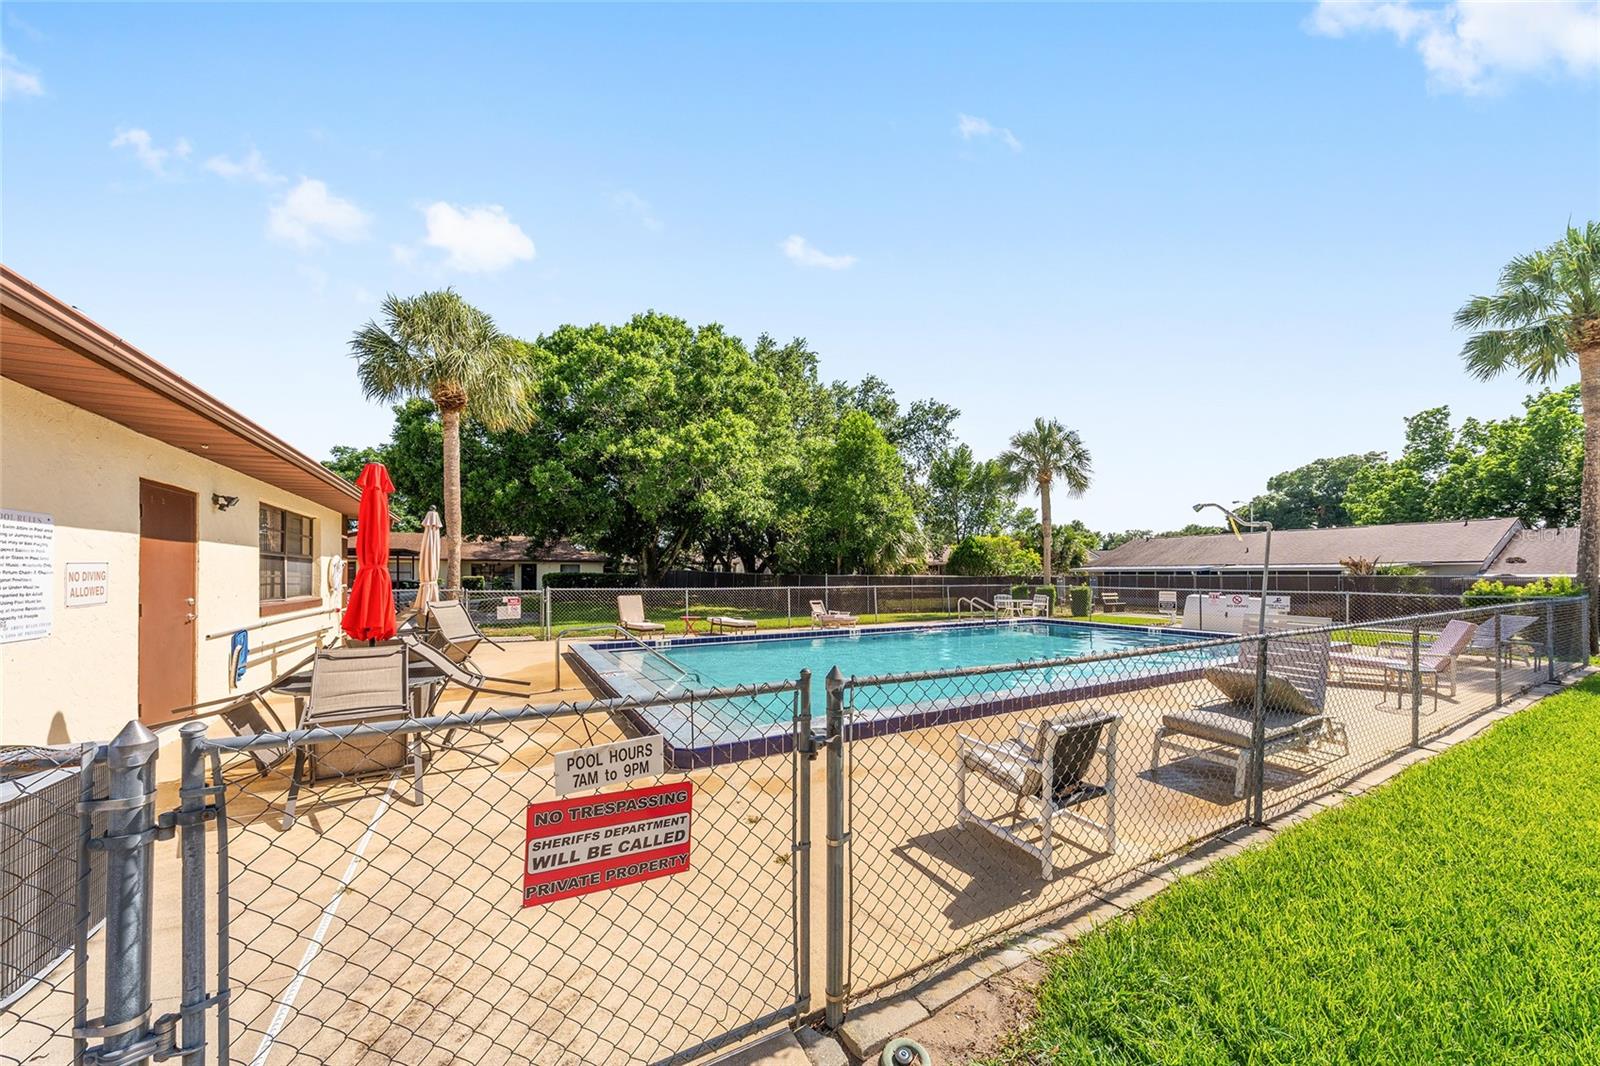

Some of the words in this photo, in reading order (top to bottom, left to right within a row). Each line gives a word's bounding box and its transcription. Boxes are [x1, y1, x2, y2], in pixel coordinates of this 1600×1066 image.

[69, 571, 80, 582] NO
[82, 571, 106, 581] DIVING
[70, 585, 105, 598] ALLOWED
[567, 753, 603, 772] POOL
[609, 743, 653, 764] HOURS
[573, 771, 598, 788] 7AM
[605, 769, 618, 782] to
[624, 760, 649, 778] 9PM
[534, 811, 563, 827] NO
[569, 791, 688, 821] TRESPASSING
[532, 830, 600, 852] SHERIFFS
[604, 815, 688, 839] DEPARTMENT
[532, 851, 580, 870] WILL
[587, 843, 613, 860] BE
[618, 829, 686, 852] CALLED
[525, 873, 601, 899] PRIVATE
[605, 853, 689, 882] PROPERTY
